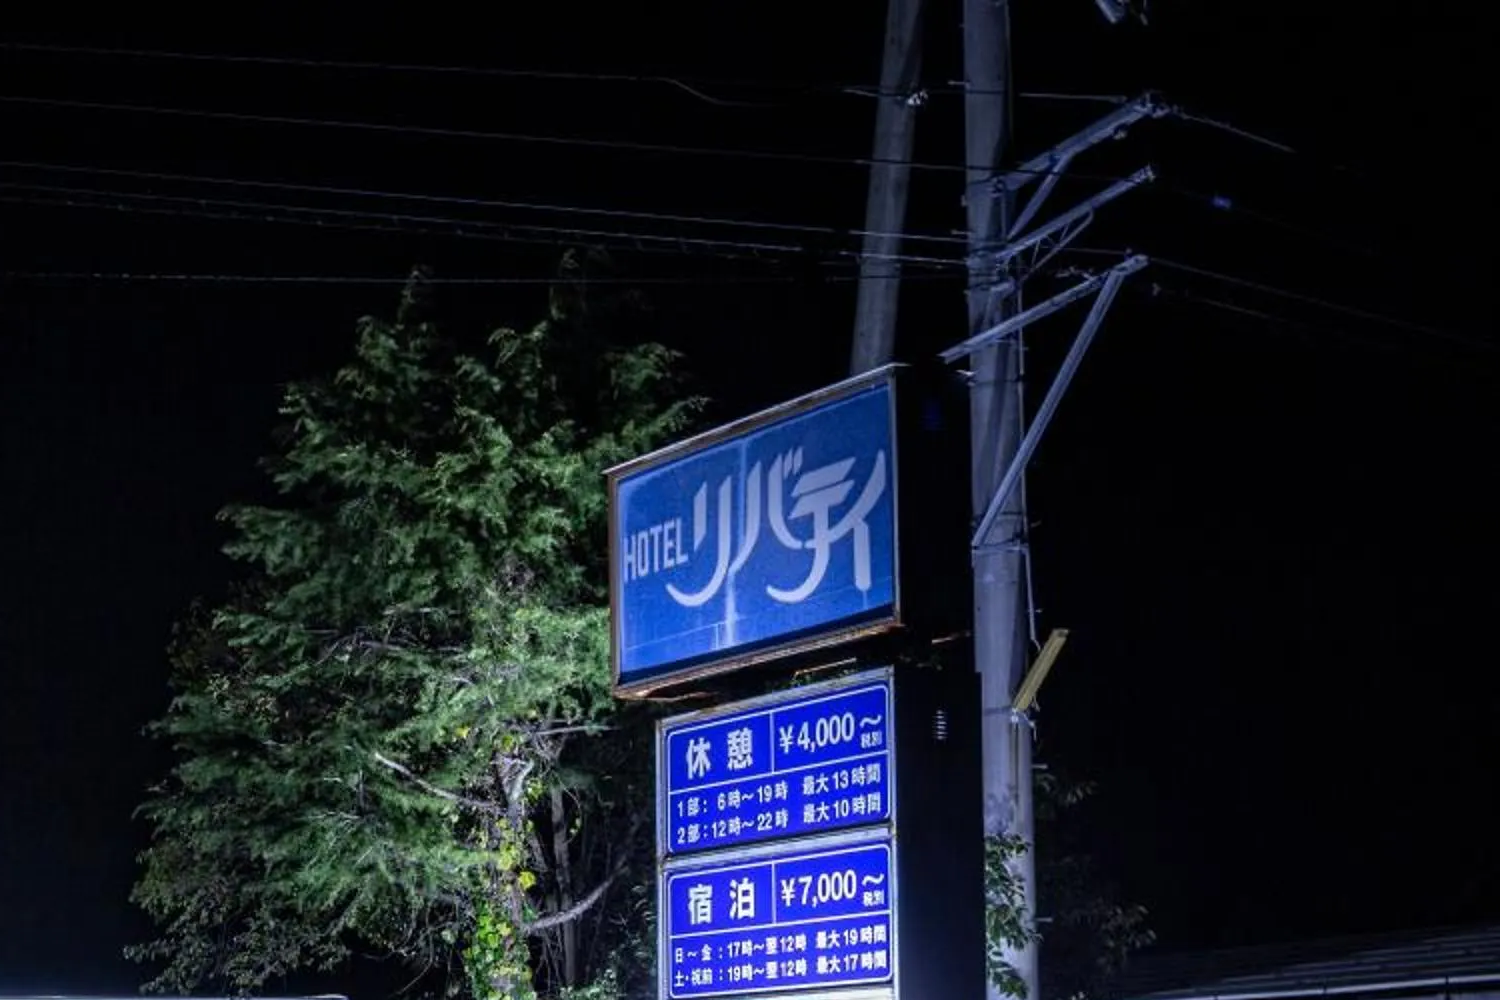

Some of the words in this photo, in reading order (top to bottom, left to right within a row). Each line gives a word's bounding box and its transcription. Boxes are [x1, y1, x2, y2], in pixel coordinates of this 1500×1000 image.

[623, 518, 689, 583] HOTEL
[666, 446, 887, 606] リバティ
